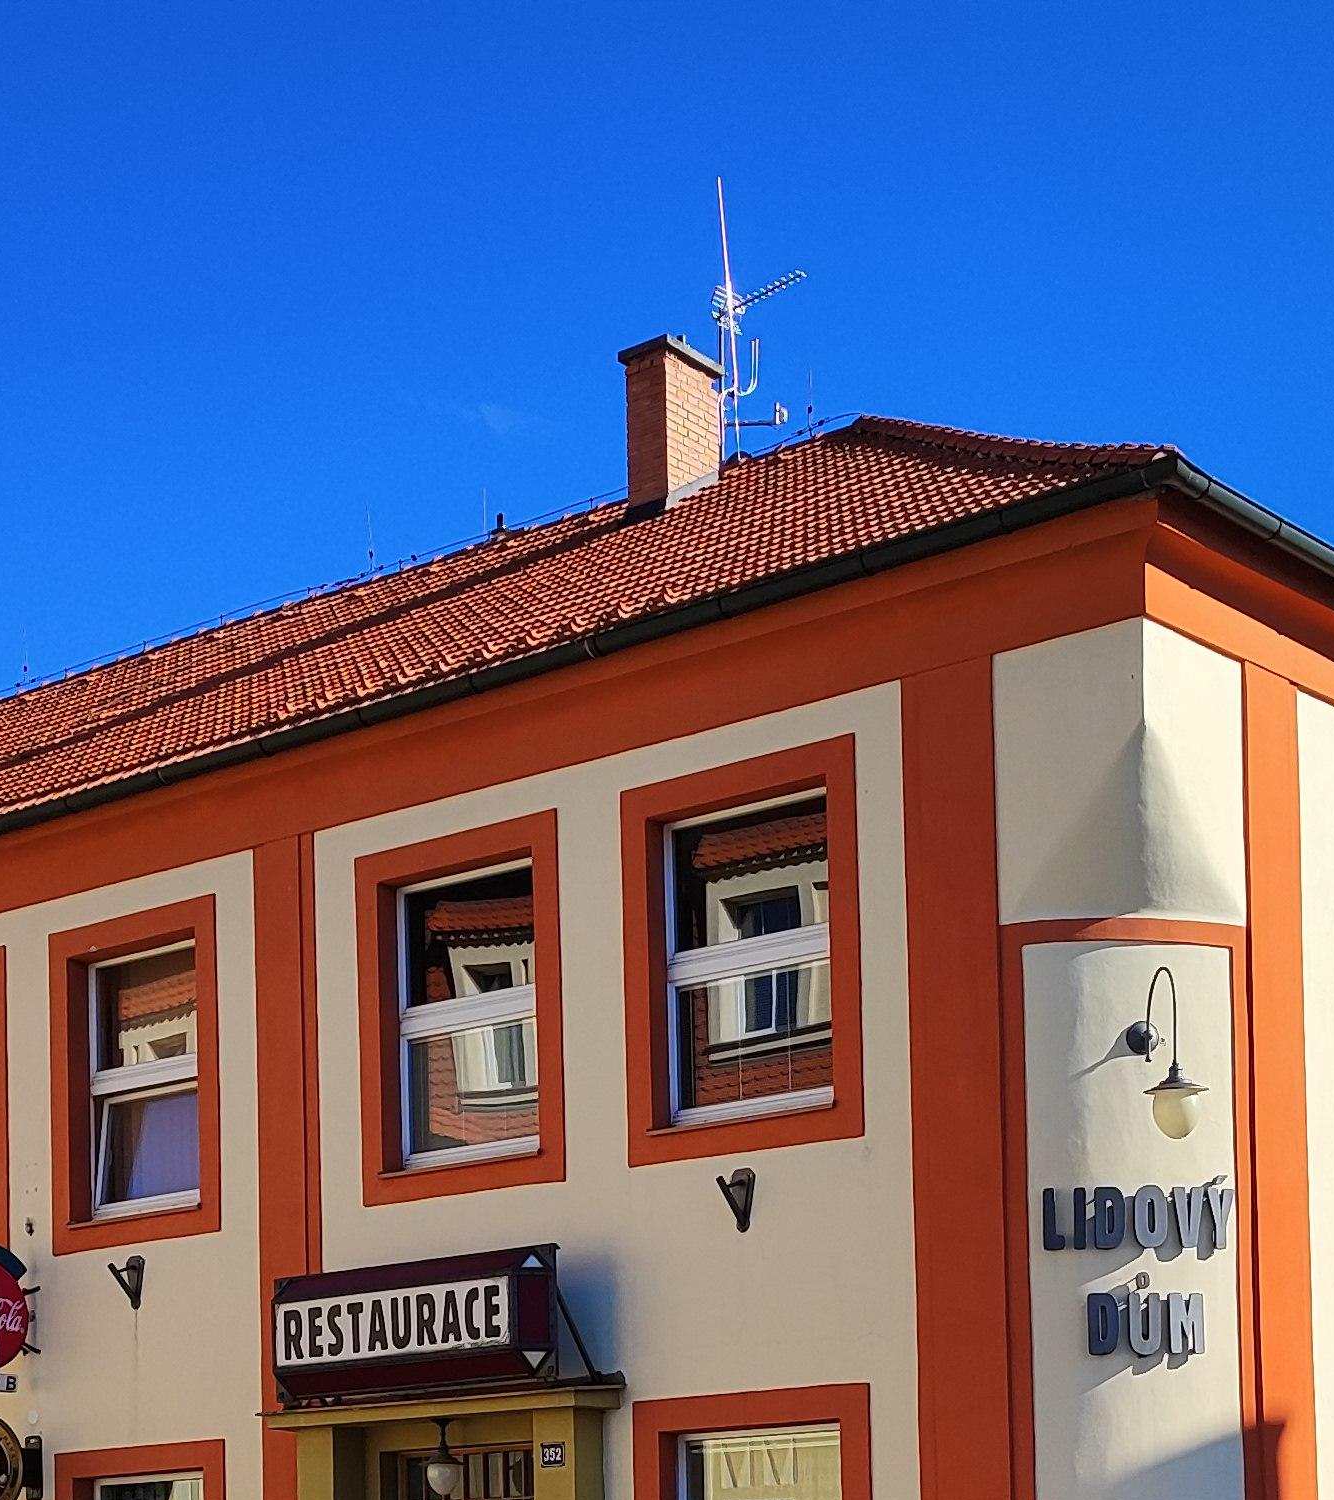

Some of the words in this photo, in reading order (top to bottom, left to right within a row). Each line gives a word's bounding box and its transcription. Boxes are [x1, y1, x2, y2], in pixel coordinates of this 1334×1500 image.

[1042, 1174, 1235, 1251] LIDOVÝ
[283, 1284, 502, 1361] RESTAURACE
[1086, 1271, 1205, 1356] DŮM
[5, 1375, 17, 1391] B
[543, 1447, 562, 1462] 352
